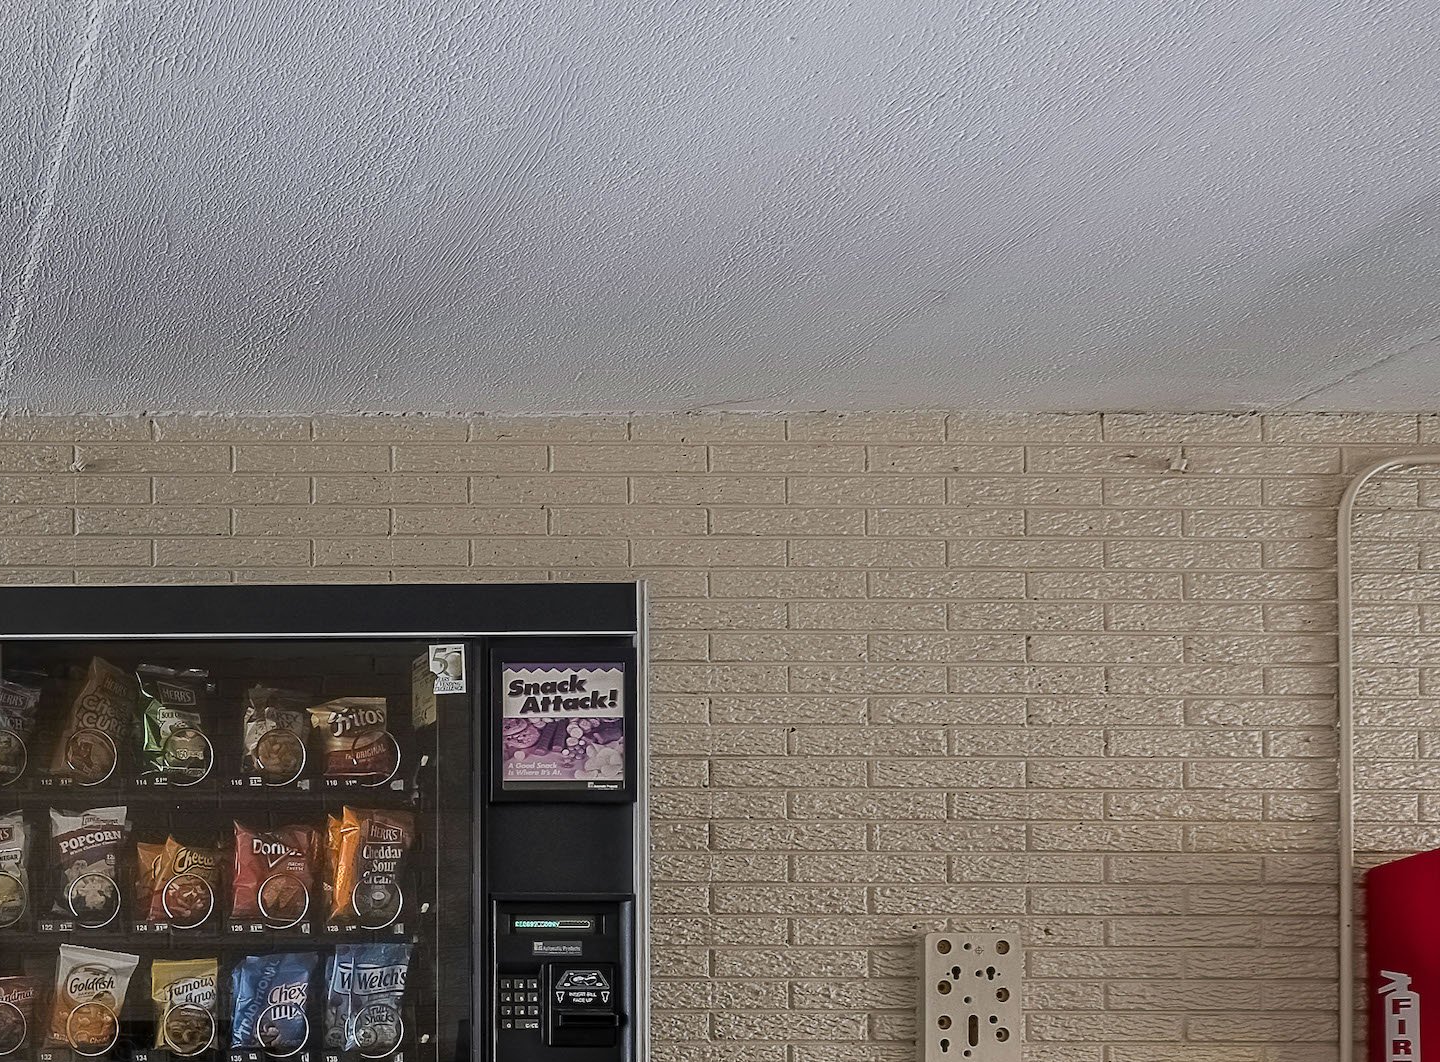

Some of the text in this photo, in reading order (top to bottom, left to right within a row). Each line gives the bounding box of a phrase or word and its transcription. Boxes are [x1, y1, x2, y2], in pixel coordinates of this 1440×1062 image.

[508, 675, 588, 697] Snack
[520, 690, 618, 714] Attack!
[60, 830, 122, 854] POPCORN
[371, 825, 398, 842] HERR'S
[363, 844, 404, 860] Cheddar
[372, 860, 397, 873] Sour
[70, 976, 116, 994] Goldfish
[168, 977, 214, 998] Famous
[357, 969, 408, 990] Welch's
[185, 990, 217, 1004] Amos
[269, 984, 308, 1004] Chex
